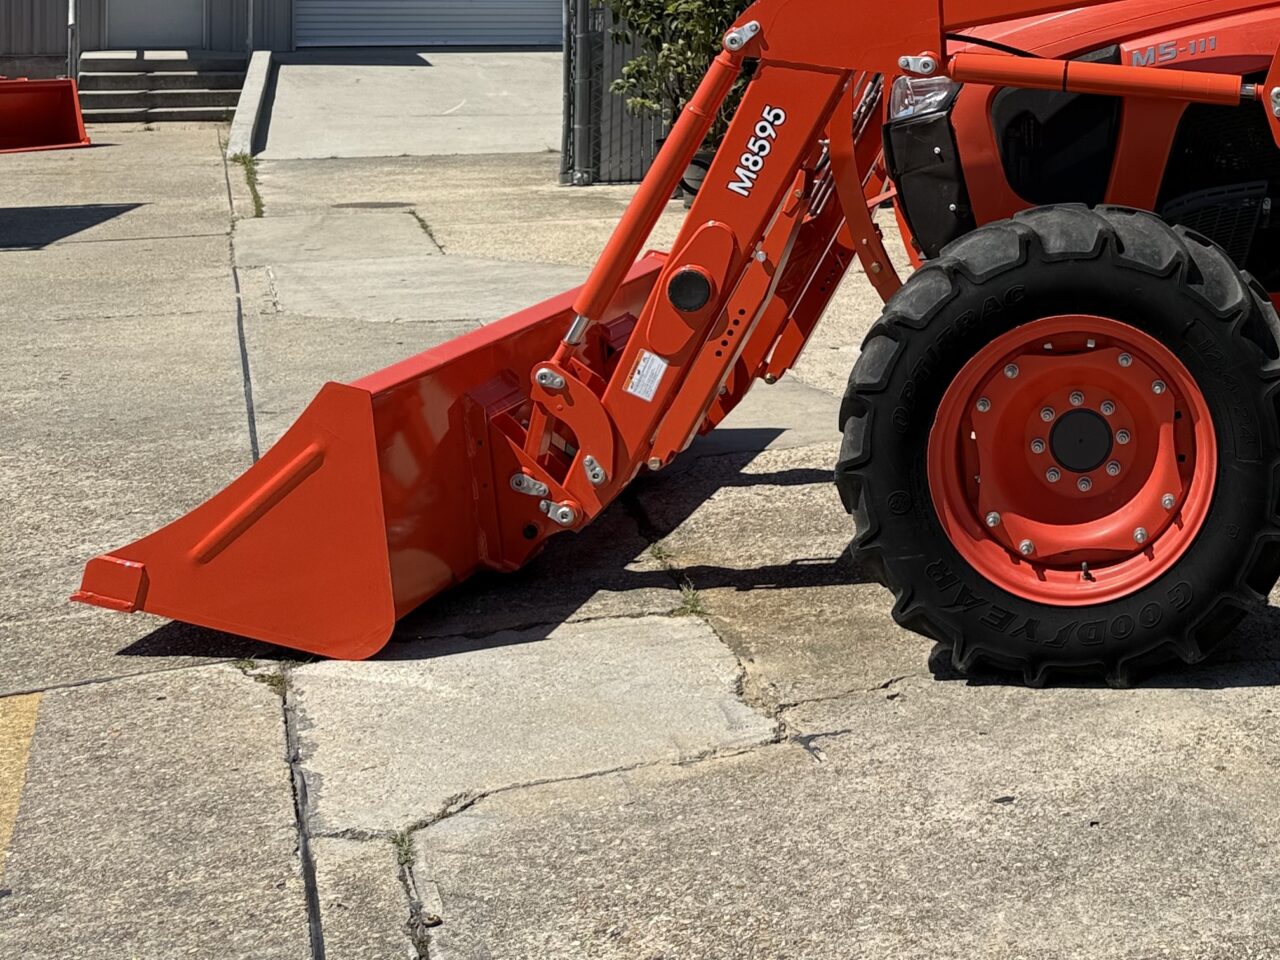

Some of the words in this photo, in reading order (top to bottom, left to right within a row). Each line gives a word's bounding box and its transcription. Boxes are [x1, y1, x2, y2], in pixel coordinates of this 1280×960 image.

[726, 104, 787, 197] M8595
[891, 284, 1025, 433] OPTITRAC
[923, 558, 1193, 649] GOODYEAR
